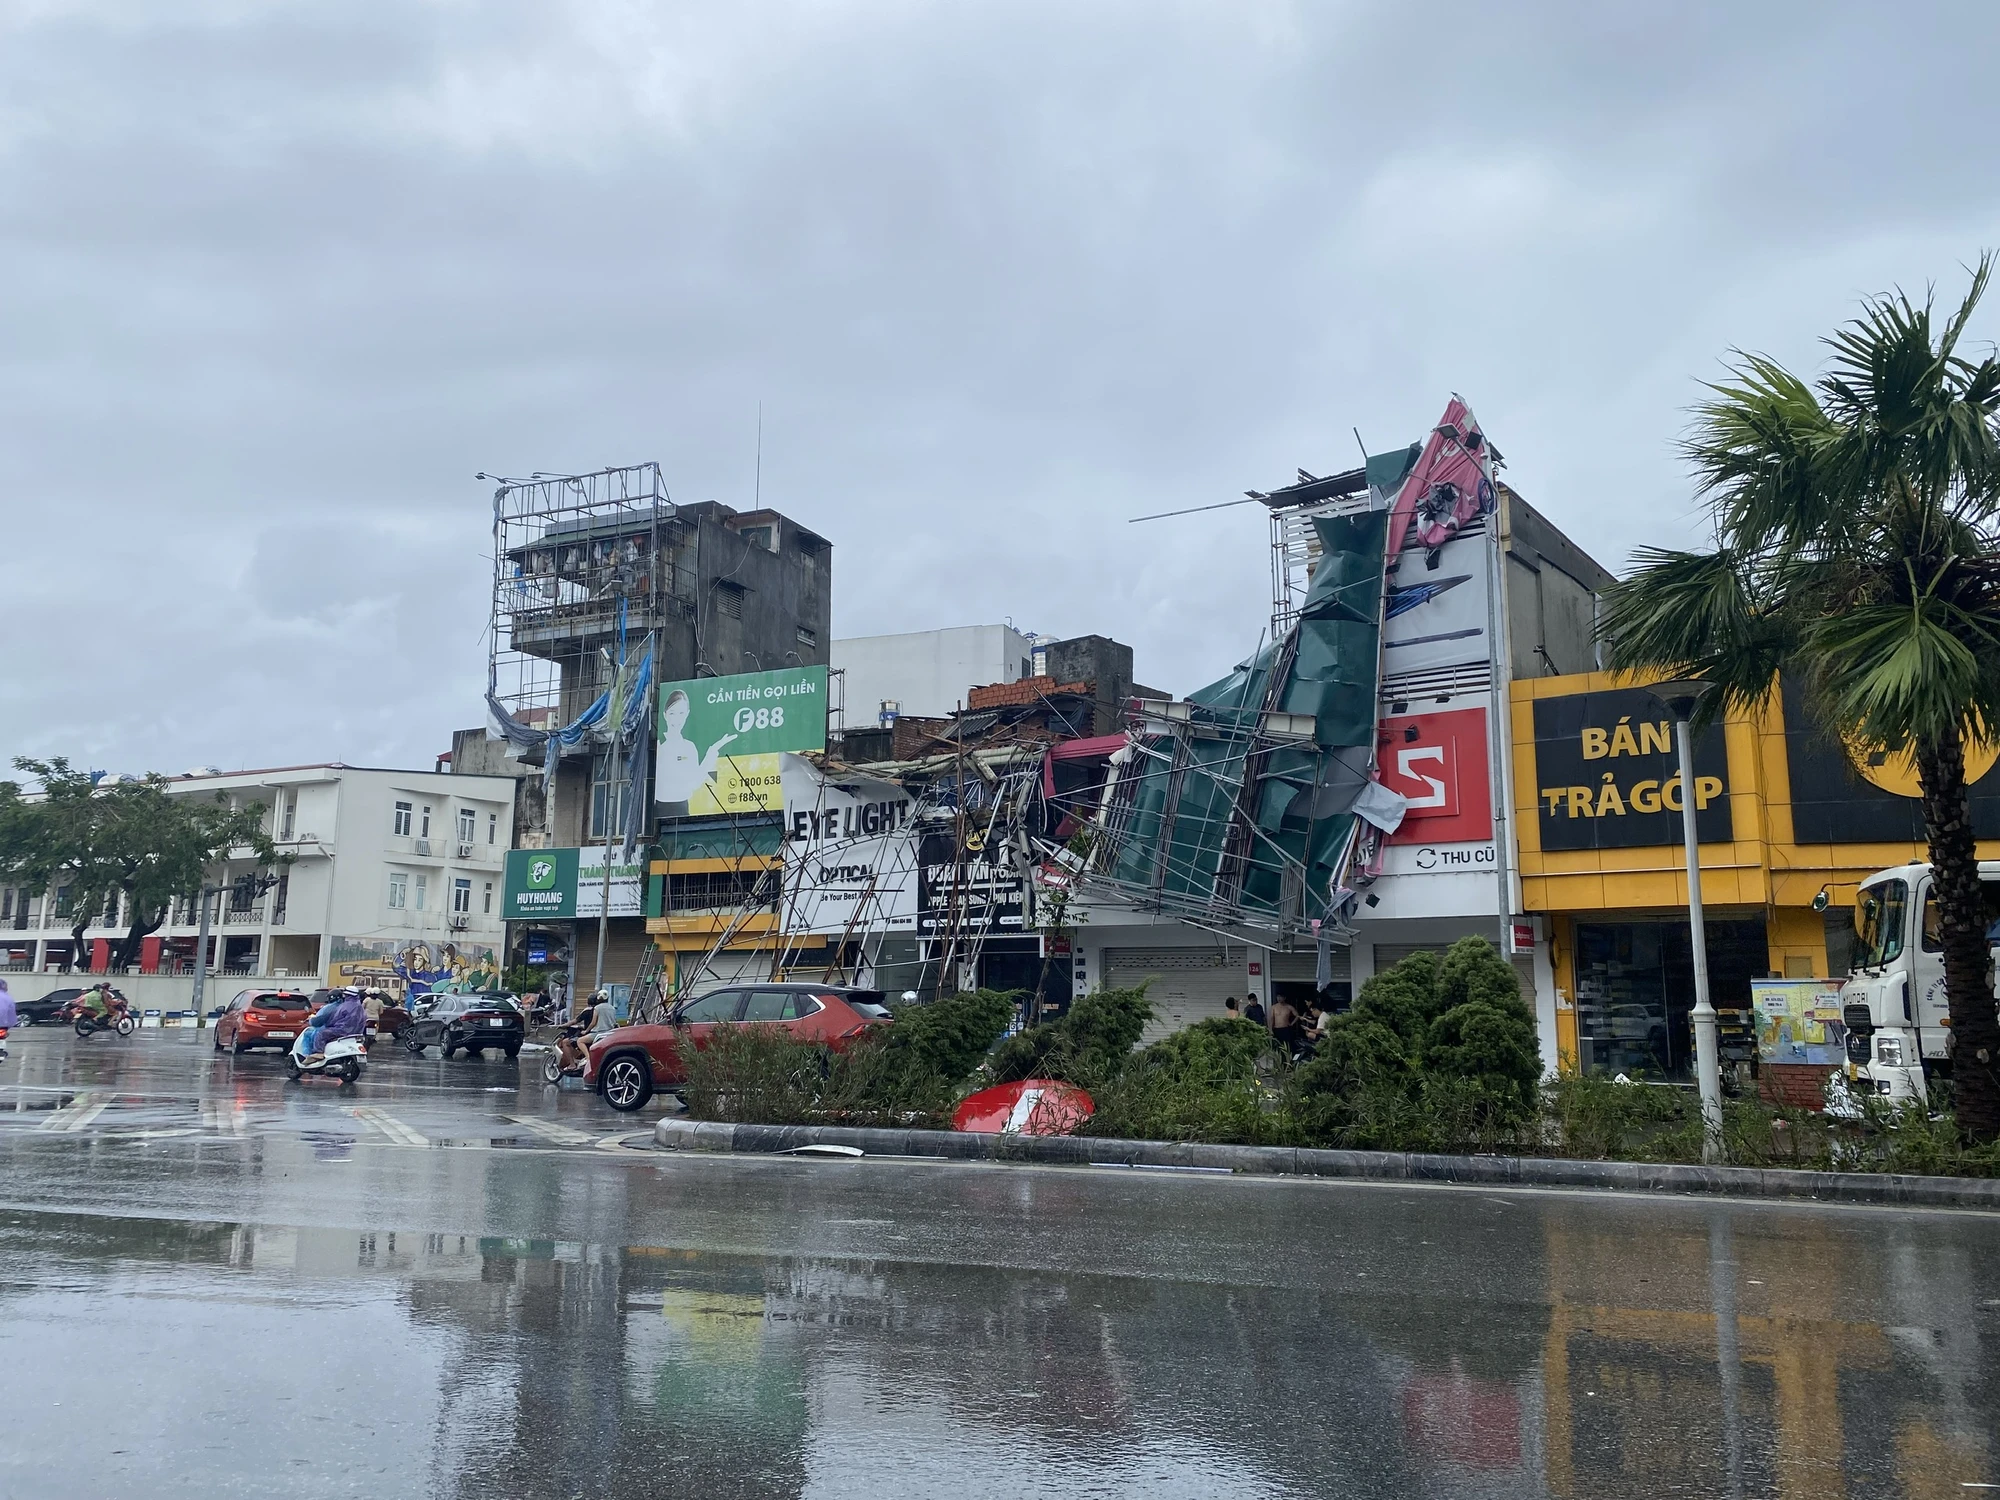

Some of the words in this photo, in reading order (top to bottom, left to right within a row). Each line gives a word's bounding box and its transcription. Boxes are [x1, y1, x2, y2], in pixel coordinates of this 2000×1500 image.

[707, 687, 733, 704] CẦN
[736, 684, 760, 701] TIỀN
[763, 686, 787, 700] GỌI
[790, 678, 815, 695] LIỀN
[1581, 715, 1671, 761] BÁN
[763, 775, 781, 786] 638
[1541, 773, 1626, 820] TRẢ
[793, 808, 839, 841] EYE
[842, 799, 909, 838] LIGHT
[1441, 850, 1471, 865] THU
[1474, 846, 1495, 862] CŨ
[579, 864, 605, 878] THÀN
[820, 863, 876, 883] OPTICAL
[829, 892, 842, 902] Your
[843, 891, 857, 900] Best
